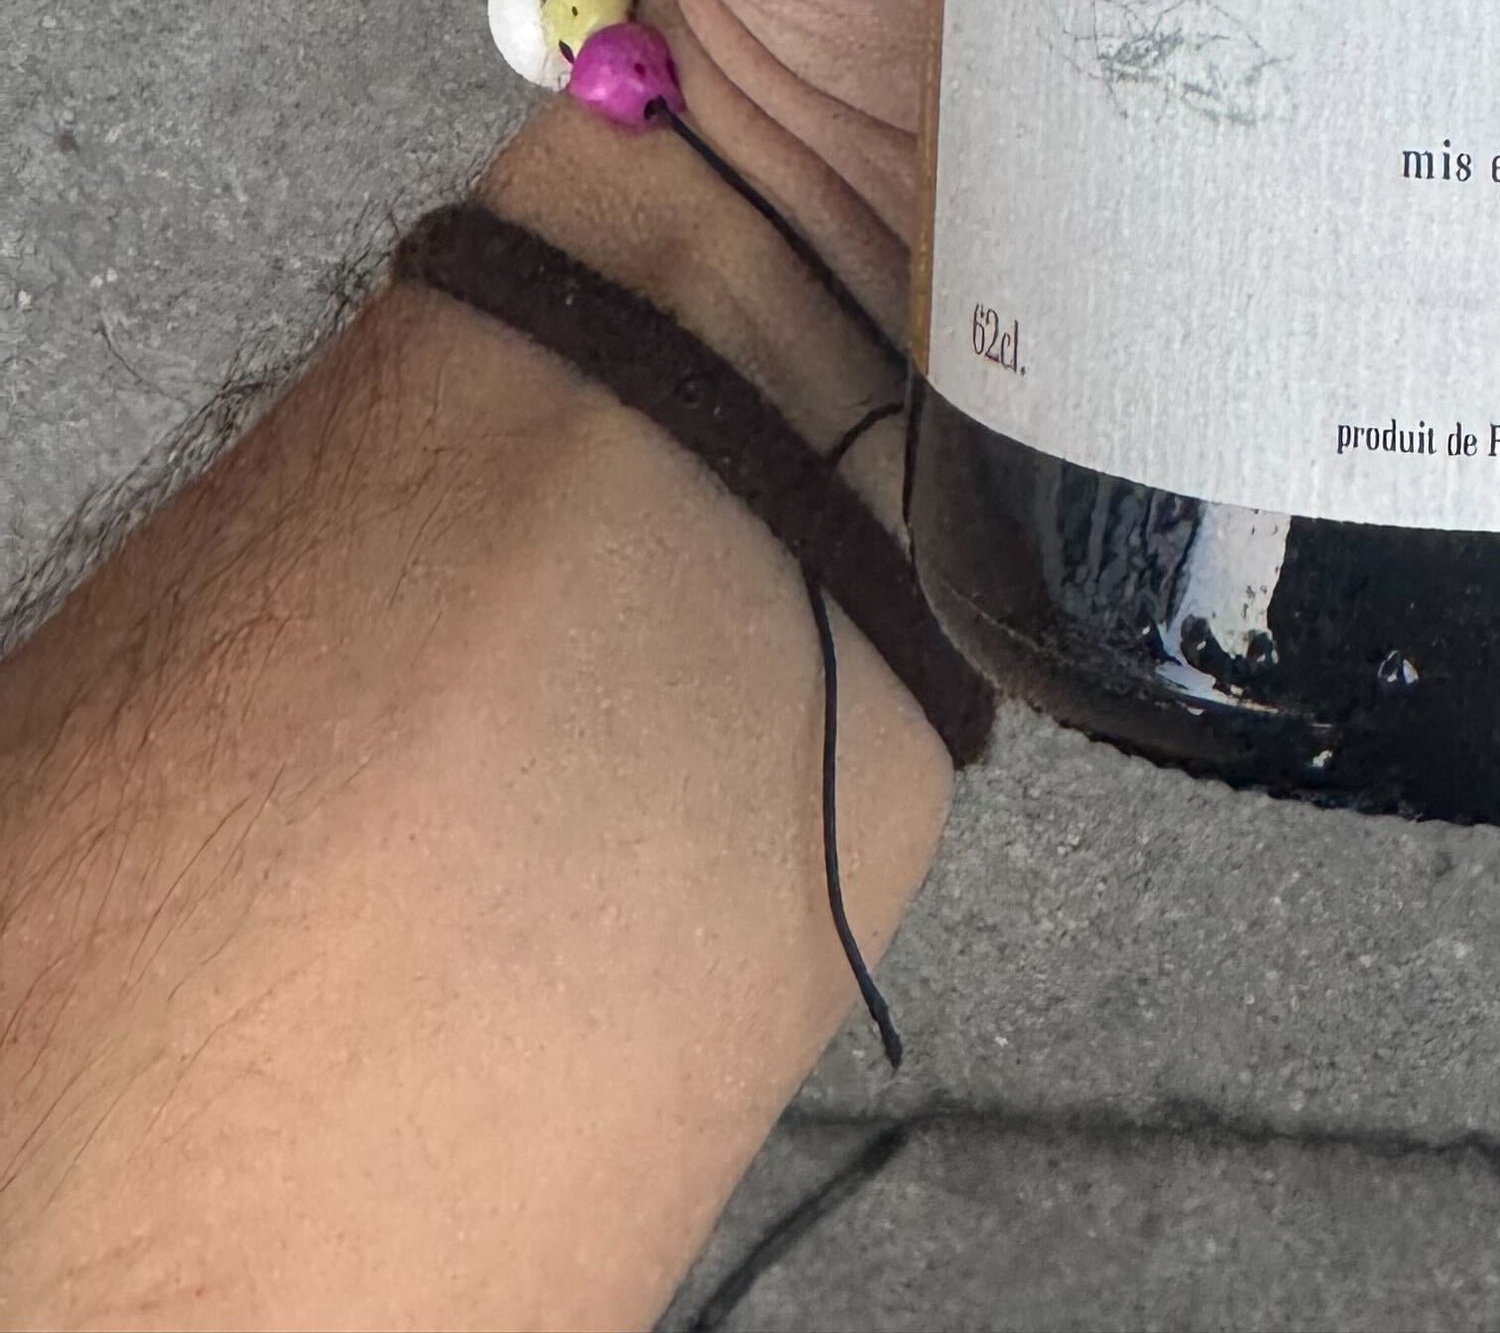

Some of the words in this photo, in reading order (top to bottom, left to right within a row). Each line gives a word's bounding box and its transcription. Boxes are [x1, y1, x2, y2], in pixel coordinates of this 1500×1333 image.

[1403, 139, 1471, 182] mis
[972, 303, 1027, 378] 62cl.
[1337, 418, 1436, 454] produit
[1448, 422, 1477, 456] de
